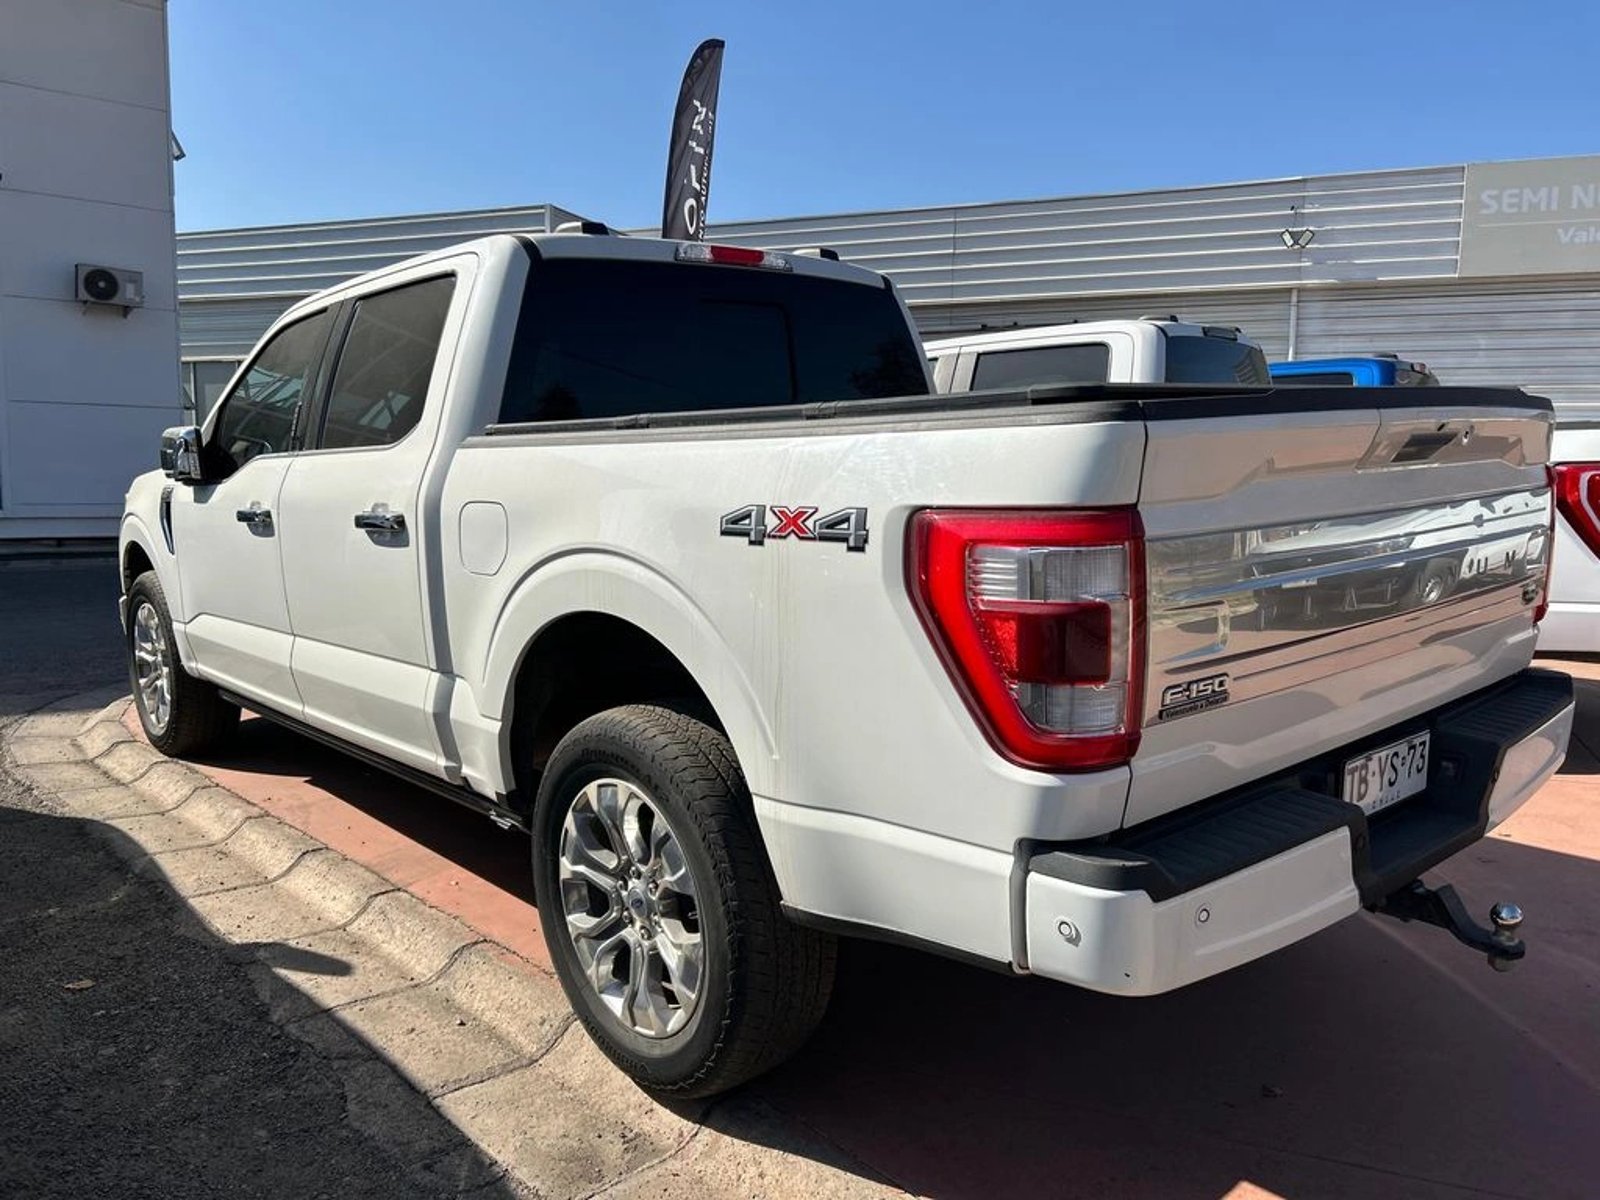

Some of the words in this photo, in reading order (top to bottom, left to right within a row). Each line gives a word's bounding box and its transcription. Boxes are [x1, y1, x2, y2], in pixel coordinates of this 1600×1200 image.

[1479, 185, 1559, 214] SEMI
[1570, 183, 1600, 210] N
[1161, 674, 1230, 706] F-150
